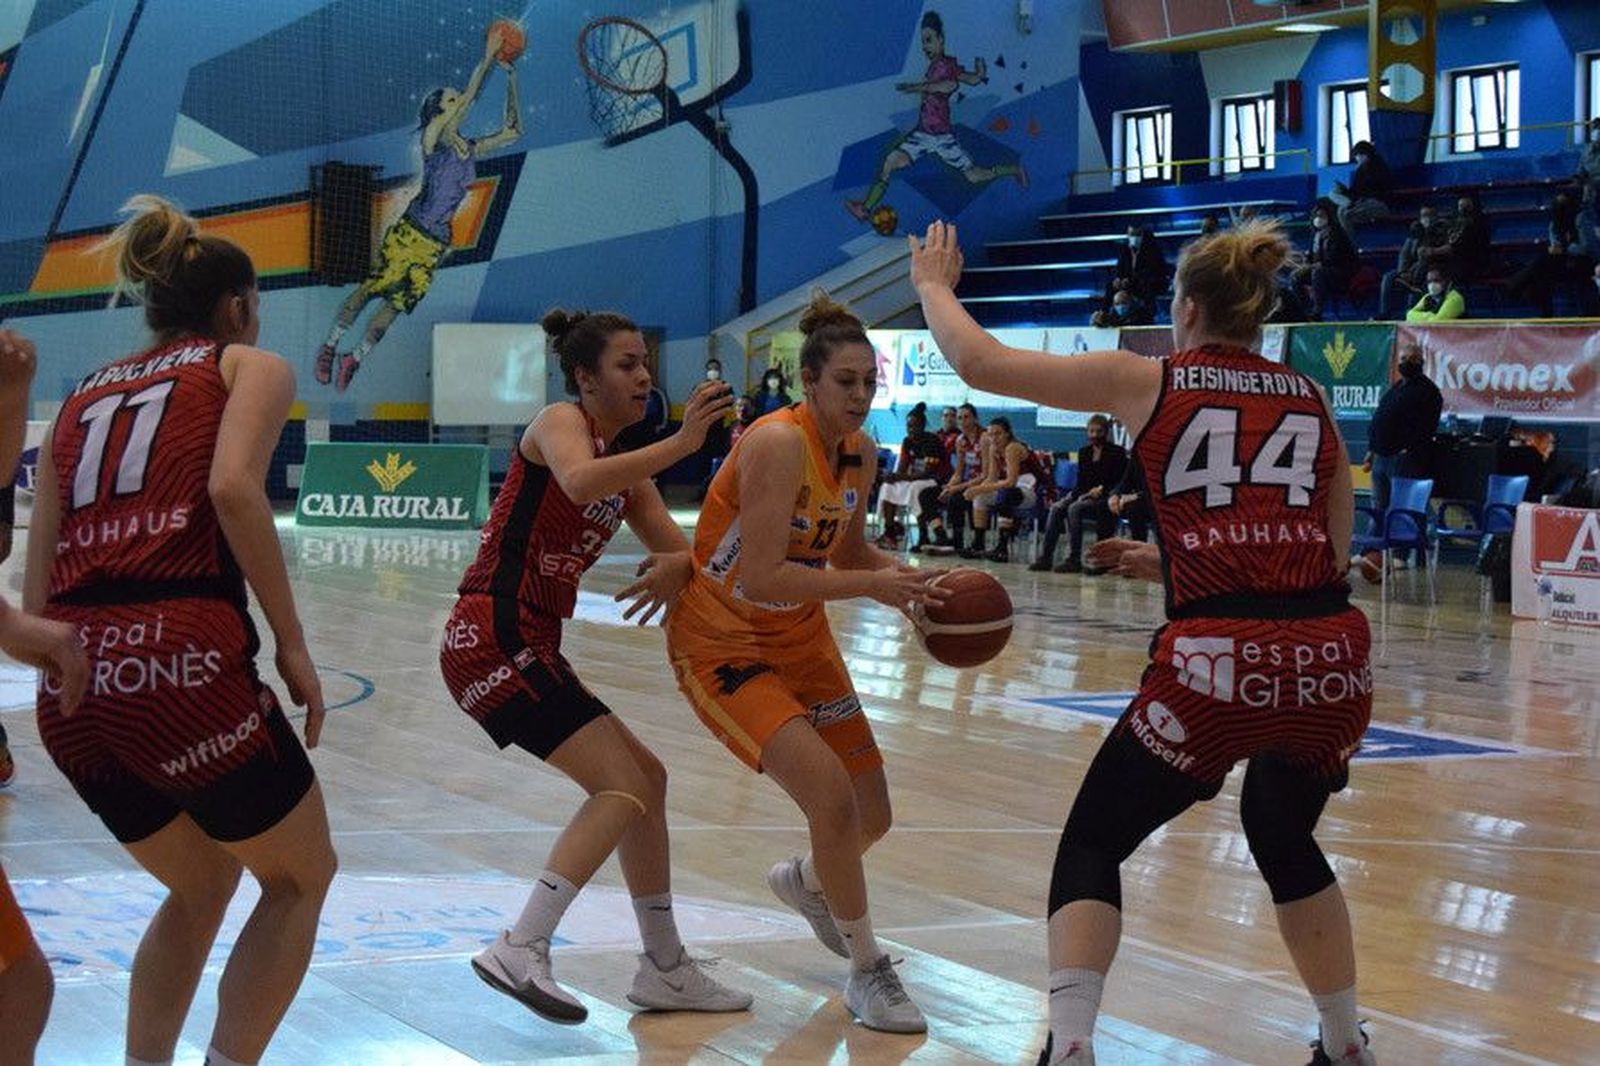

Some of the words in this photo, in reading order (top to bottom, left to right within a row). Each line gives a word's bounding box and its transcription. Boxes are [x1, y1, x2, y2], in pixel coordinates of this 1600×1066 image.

[1173, 365, 1313, 399] REISINGEROVA
[1435, 350, 1575, 393] Kromex
[73, 380, 176, 510] 11
[1164, 407, 1321, 508] 44
[301, 494, 368, 519] CAJA
[370, 495, 470, 520] RURAL
[78, 613, 164, 657] spai
[1242, 633, 1353, 674] espai
[159, 711, 261, 777] wifiboo
[1130, 709, 1196, 772] infoself
